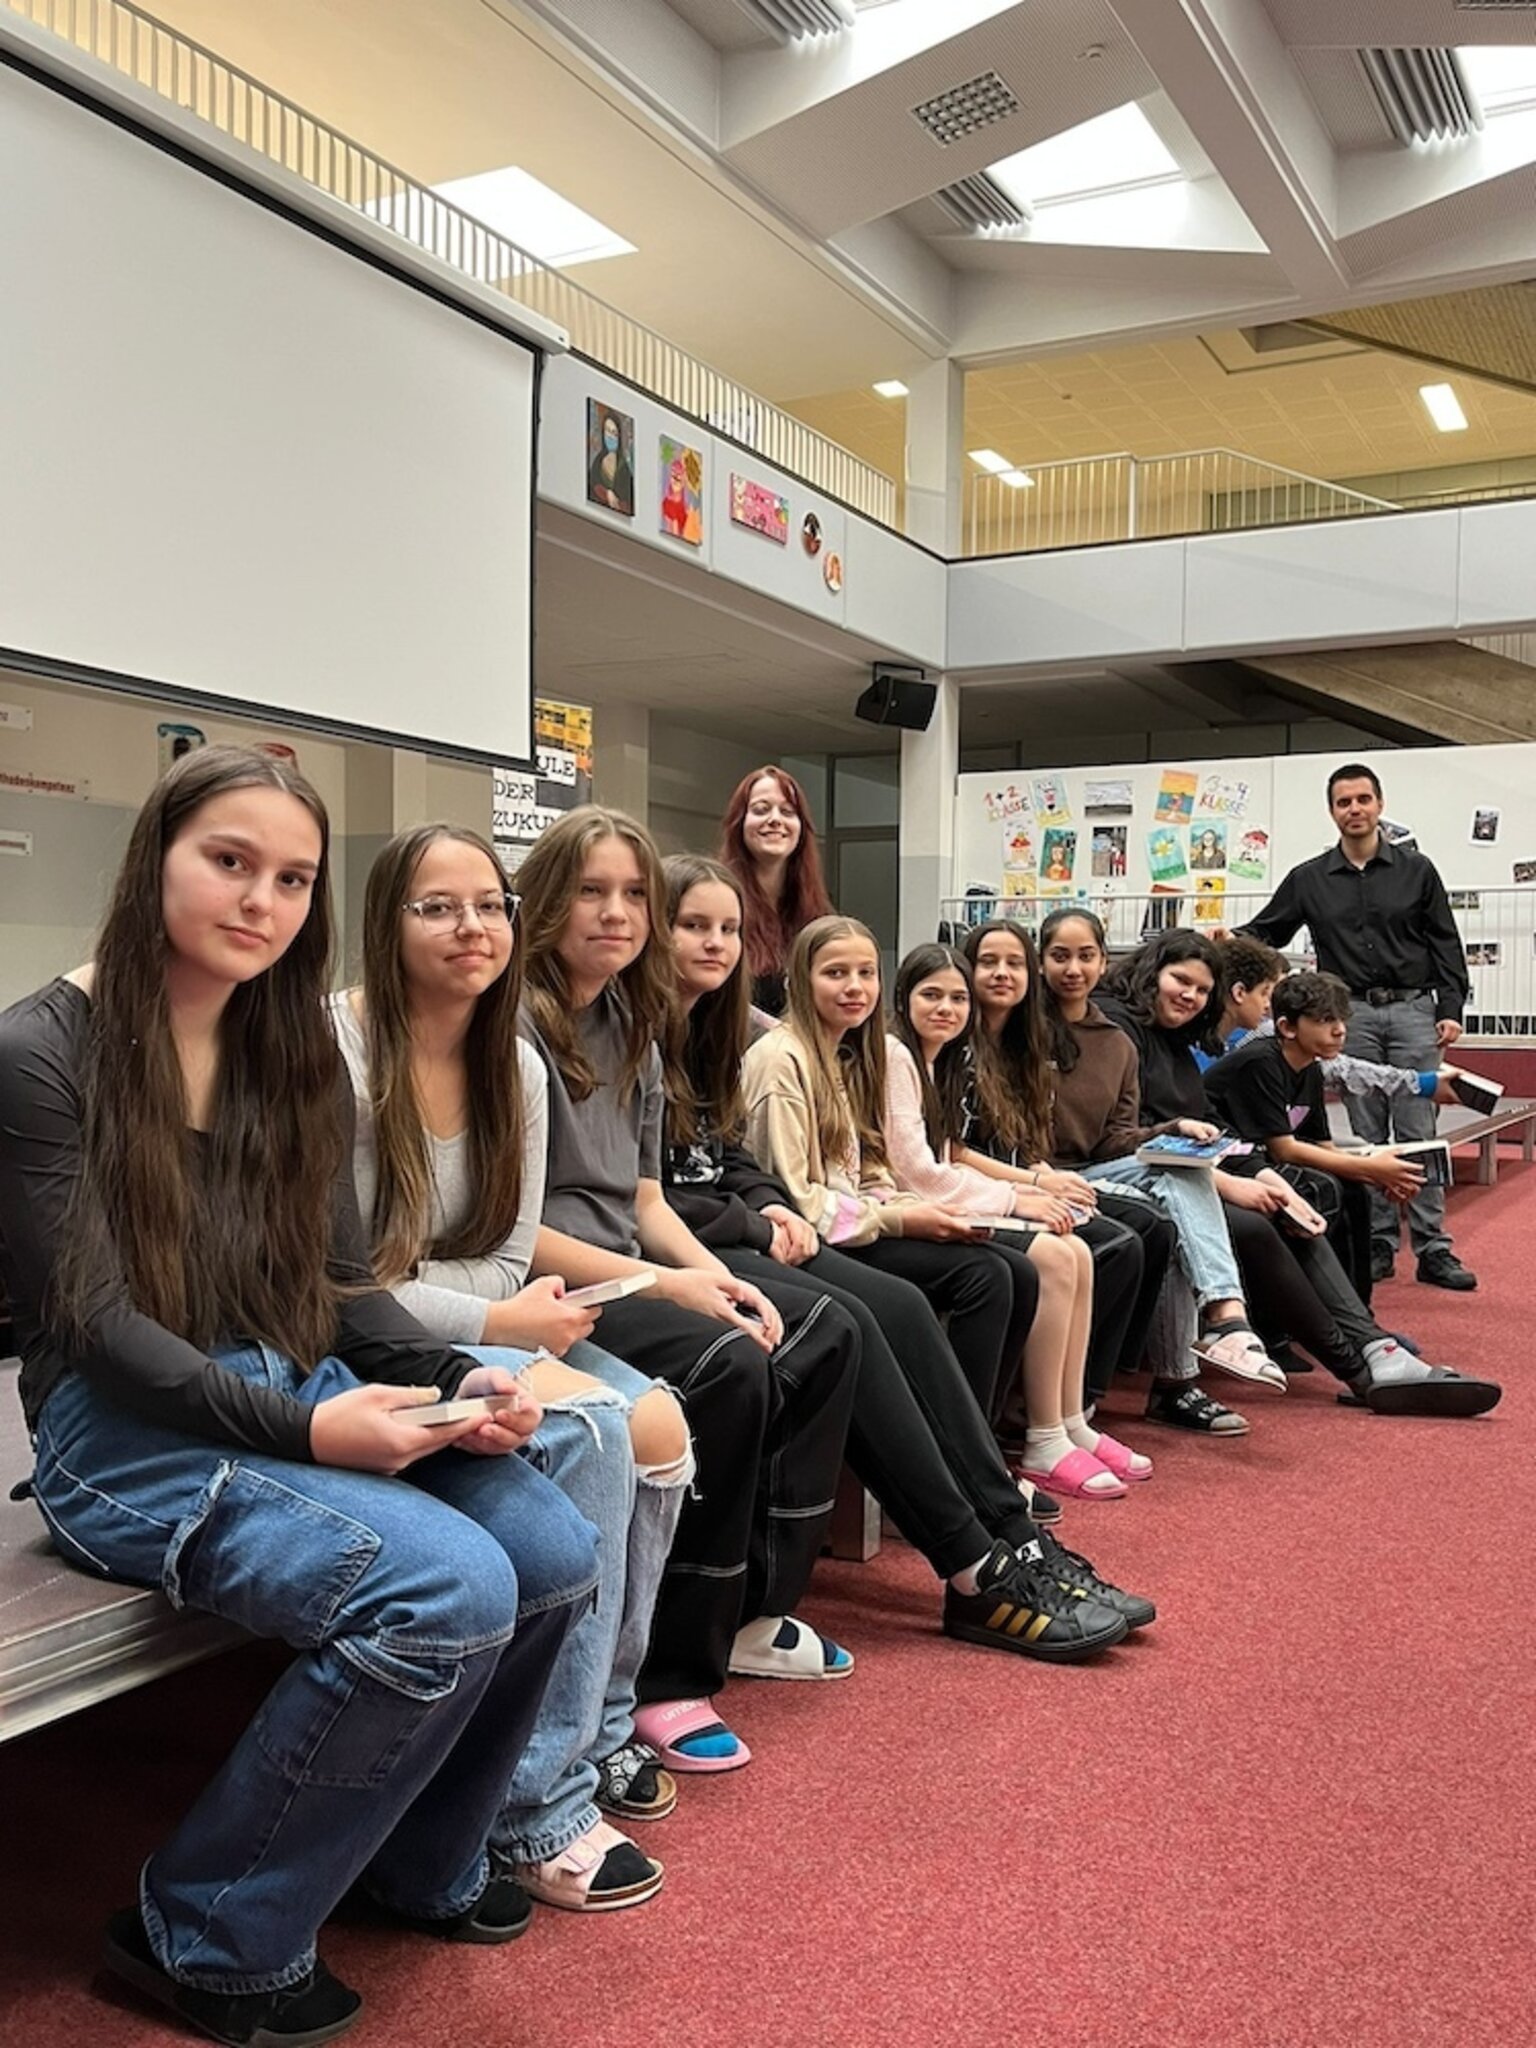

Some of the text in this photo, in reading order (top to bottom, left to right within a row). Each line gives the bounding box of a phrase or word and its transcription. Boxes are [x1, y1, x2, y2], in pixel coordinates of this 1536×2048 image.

[494, 780, 534, 800] DER
[983, 792, 993, 806] 1
[1007, 785, 1019, 798] 2
